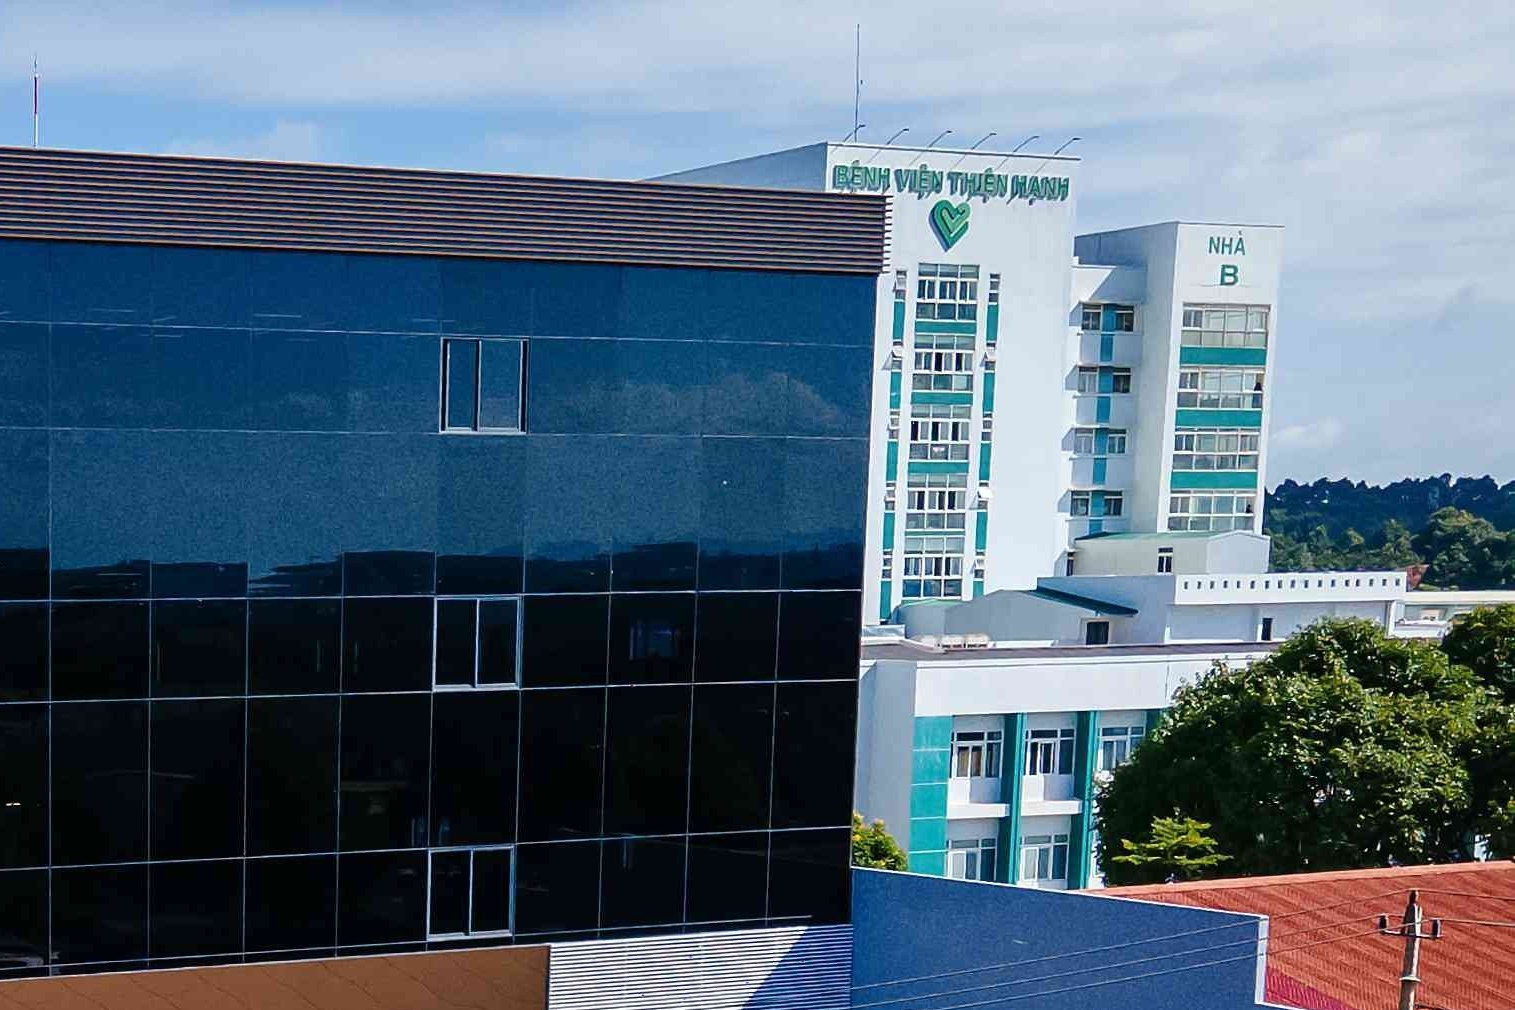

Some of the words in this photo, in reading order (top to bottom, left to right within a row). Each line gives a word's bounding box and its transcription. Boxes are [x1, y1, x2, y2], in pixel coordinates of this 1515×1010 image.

[893, 163, 944, 200] VIỆN
[947, 167, 1009, 203] THIỆN
[1208, 230, 1246, 256] NHÀ
[1220, 264, 1239, 286] B
